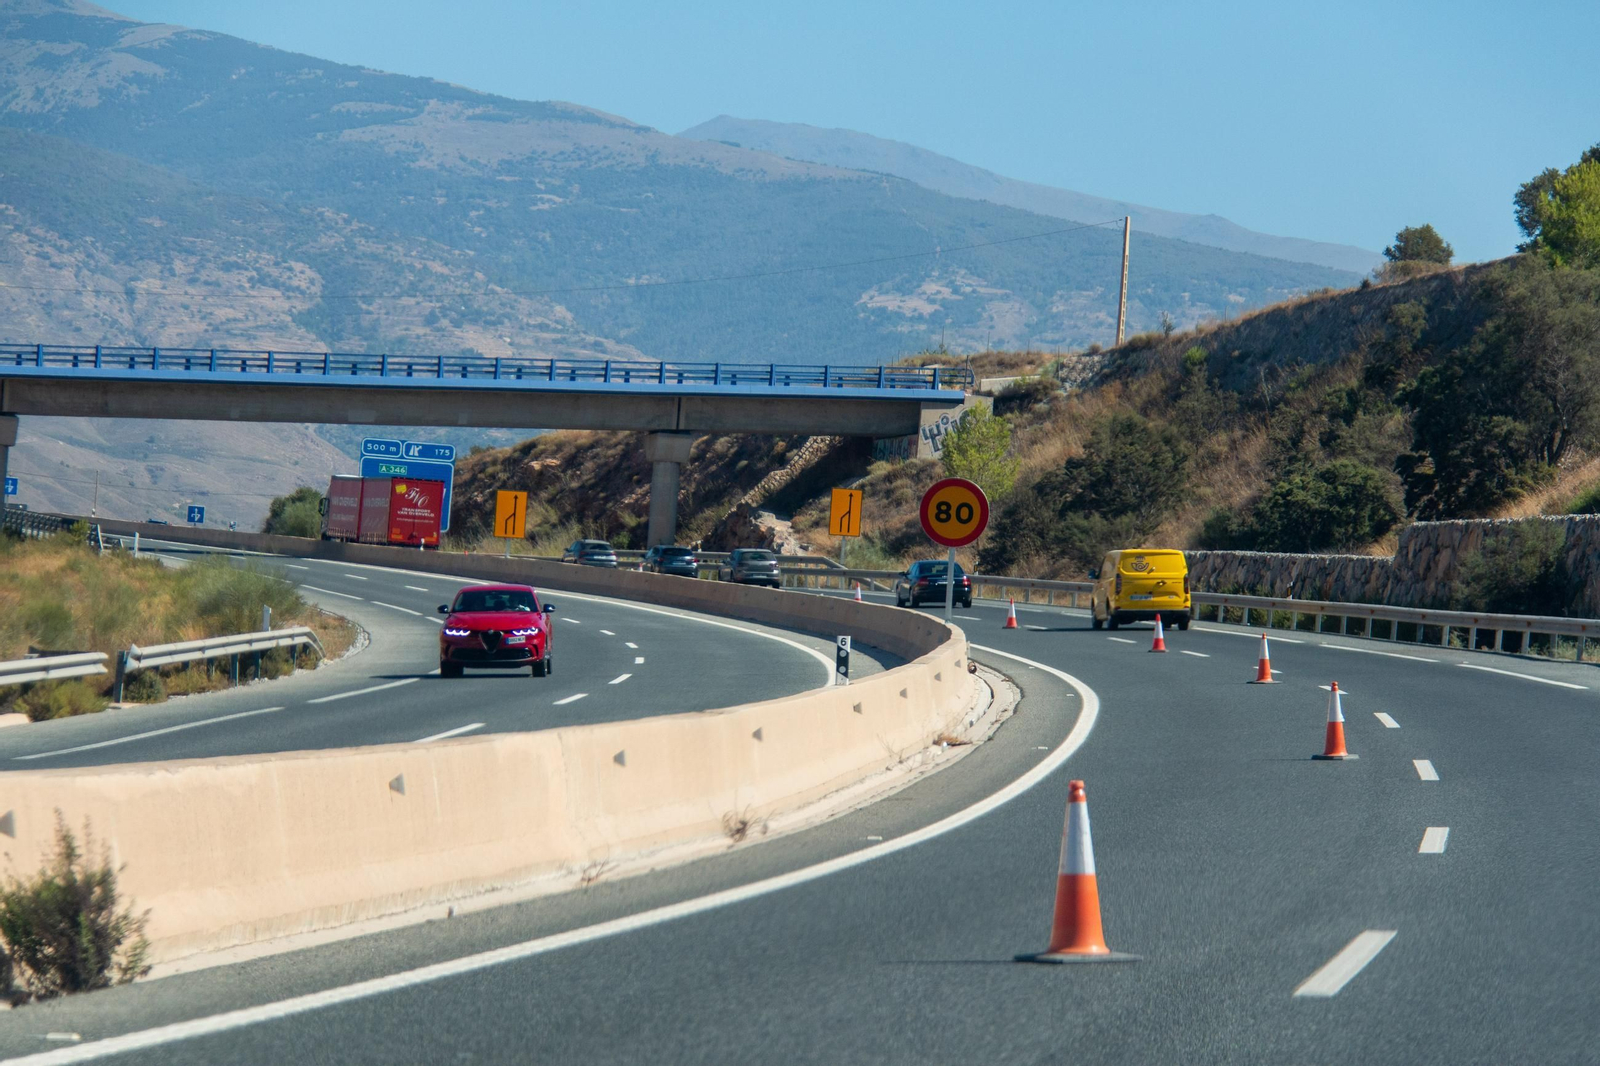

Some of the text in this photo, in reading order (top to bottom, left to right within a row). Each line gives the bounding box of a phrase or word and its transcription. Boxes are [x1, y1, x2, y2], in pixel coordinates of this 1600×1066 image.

[367, 443, 386, 451] 500
[935, 501, 974, 525] 80
[840, 637, 847, 646] 6
